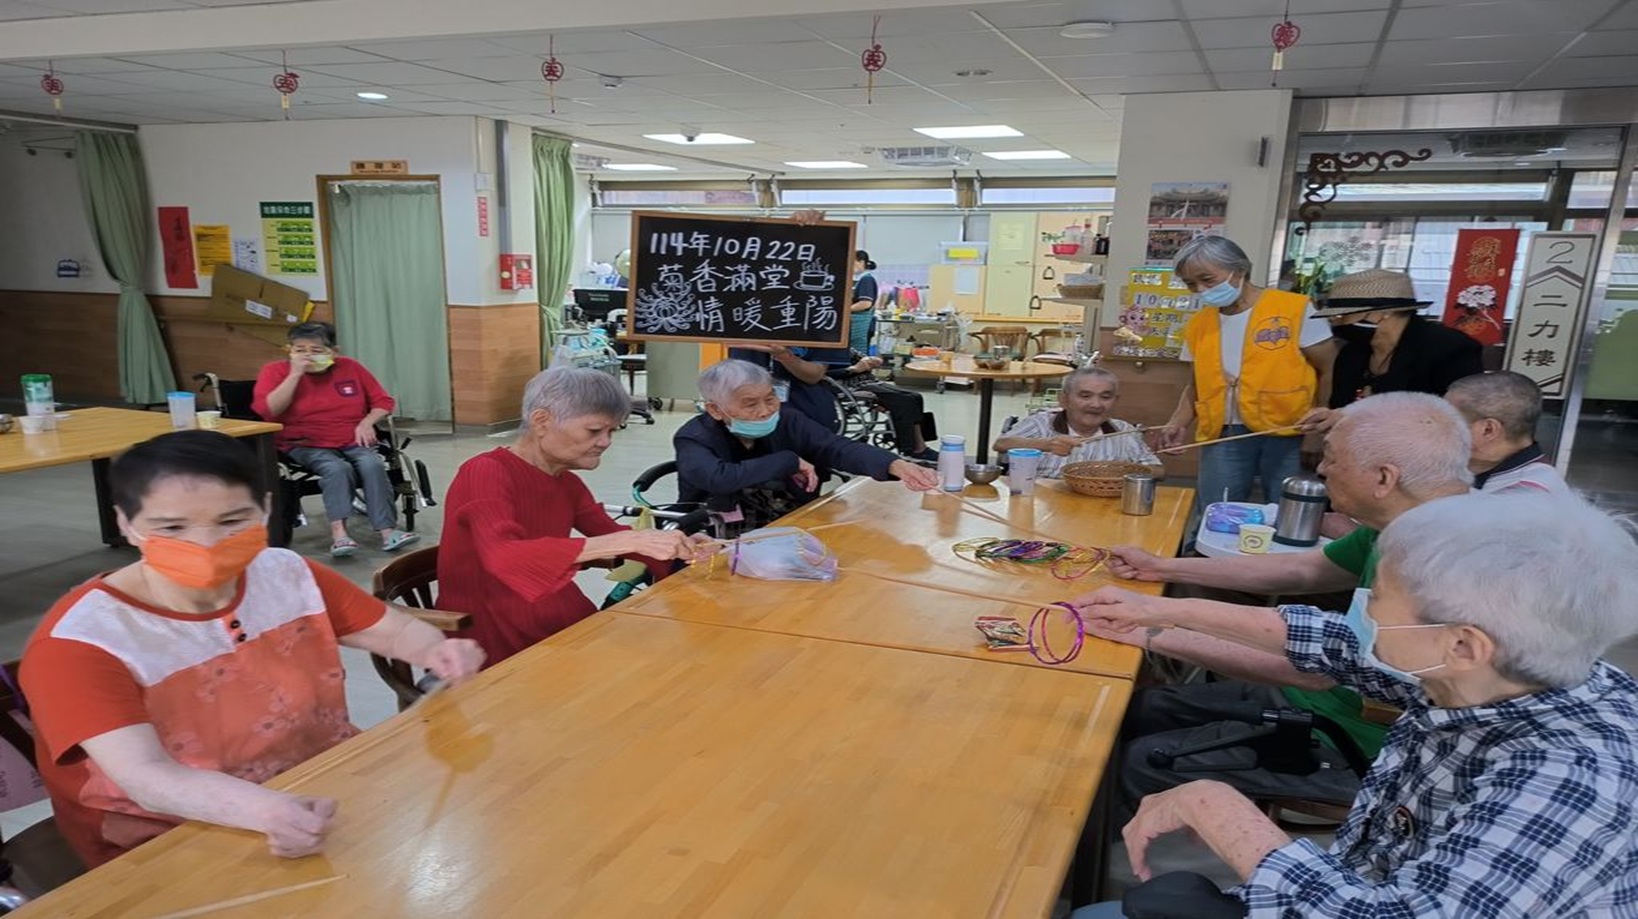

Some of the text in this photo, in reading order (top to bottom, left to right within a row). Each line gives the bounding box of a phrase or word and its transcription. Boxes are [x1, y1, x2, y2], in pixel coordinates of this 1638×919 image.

[649, 231, 816, 262] 114年10月22日
[1546, 240, 1575, 264] 2
[656, 259, 790, 293] 菊香滿堂
[696, 294, 838, 333] 情暖重陽
[1521, 294, 1568, 367] 二力樓
